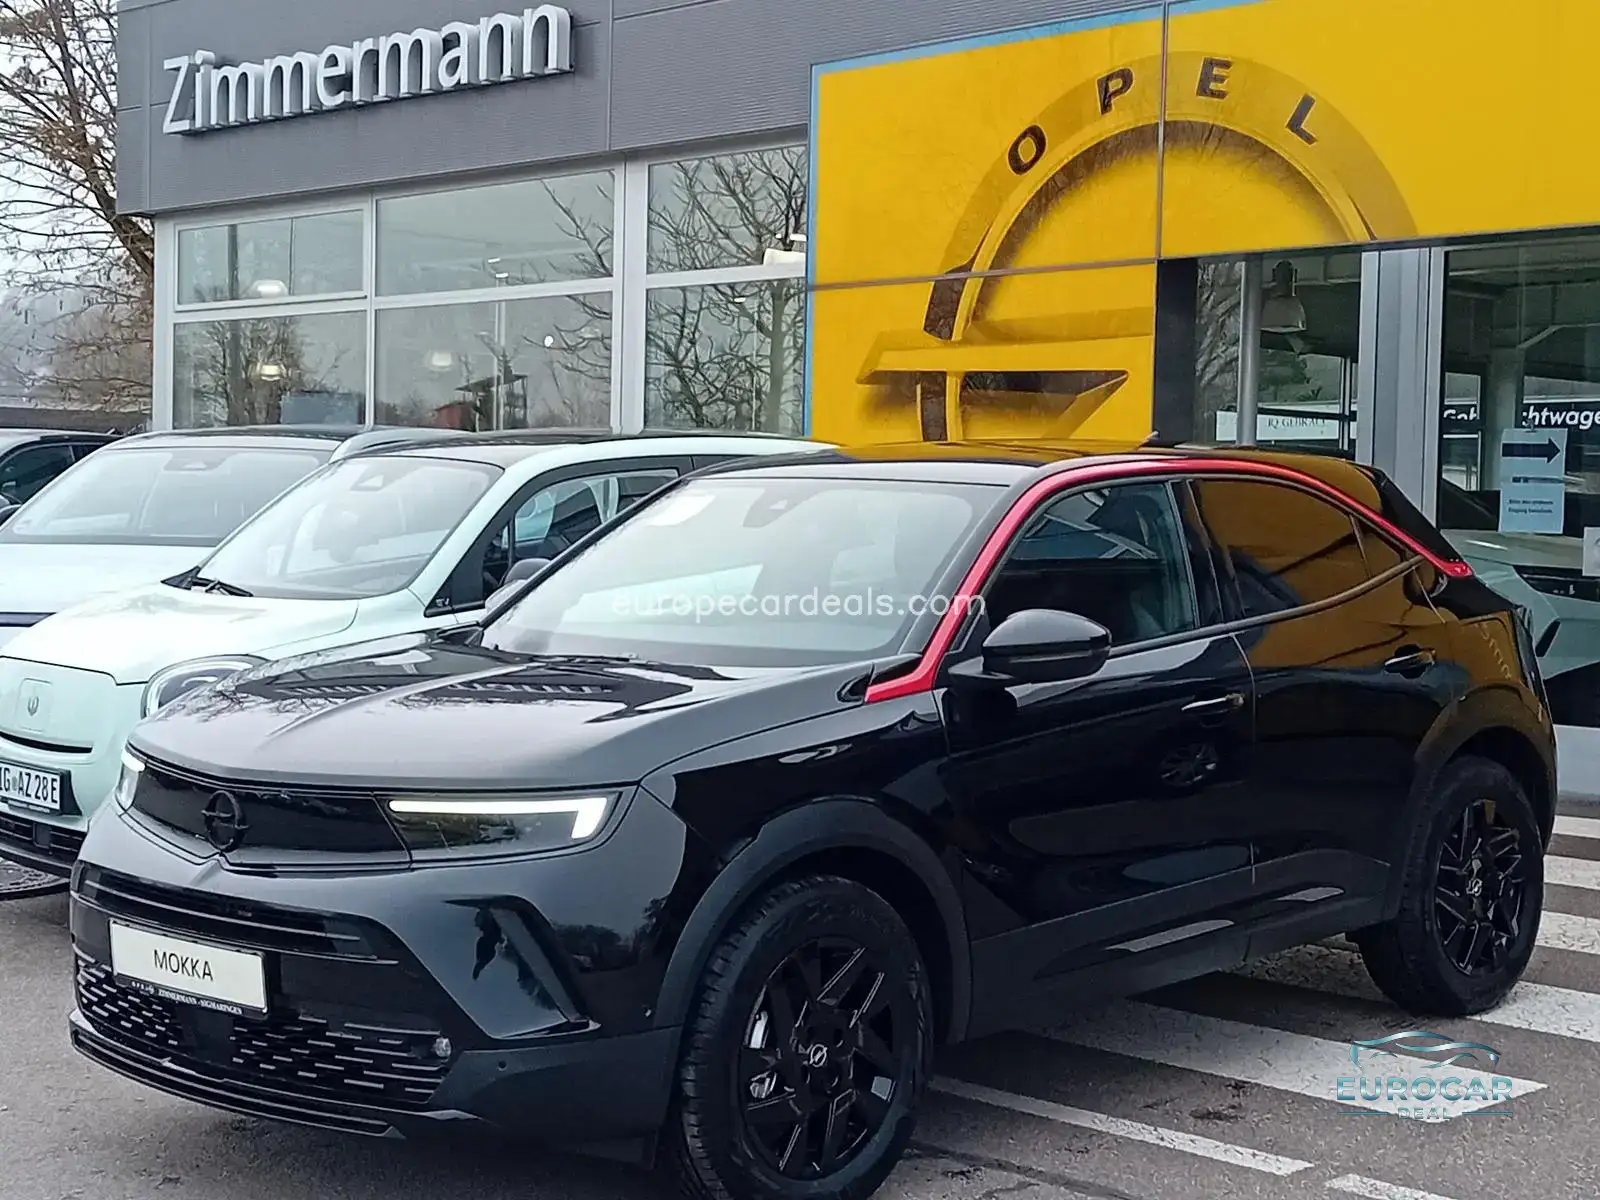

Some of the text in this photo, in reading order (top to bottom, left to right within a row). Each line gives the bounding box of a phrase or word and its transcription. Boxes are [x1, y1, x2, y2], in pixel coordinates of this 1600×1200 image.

[163, 4, 574, 135] Zimmermann
[1008, 56, 1320, 175] OPEL
[18, 771, 32, 798] AZ
[154, 949, 214, 981] MOKKA
